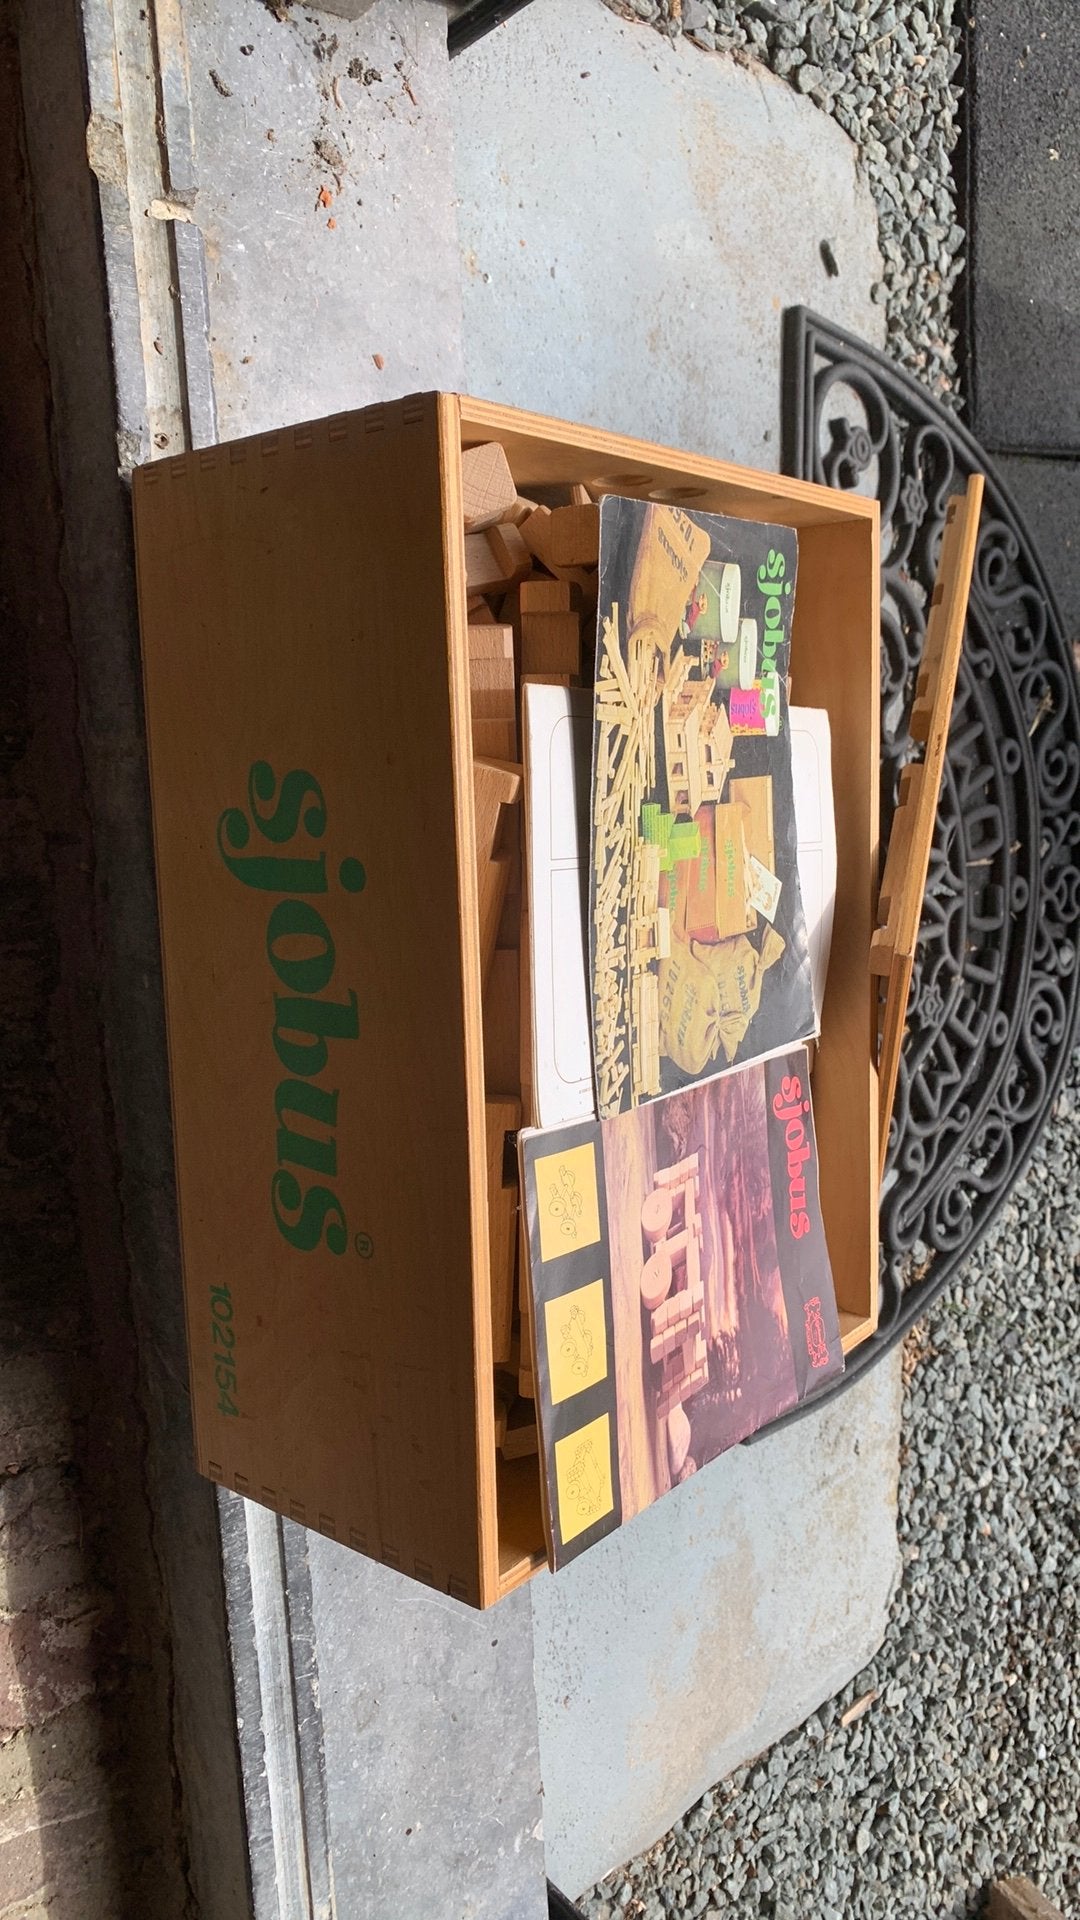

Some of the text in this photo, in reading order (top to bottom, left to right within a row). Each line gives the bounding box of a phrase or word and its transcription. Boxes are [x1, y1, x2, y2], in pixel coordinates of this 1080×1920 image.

[756, 548, 792, 719] sjobus
[914, 684, 1005, 1119] WELCOM
[216, 760, 367, 1255] sjobus
[773, 1075, 813, 1240] sjobus
[208, 1281, 240, 1419] 102154
